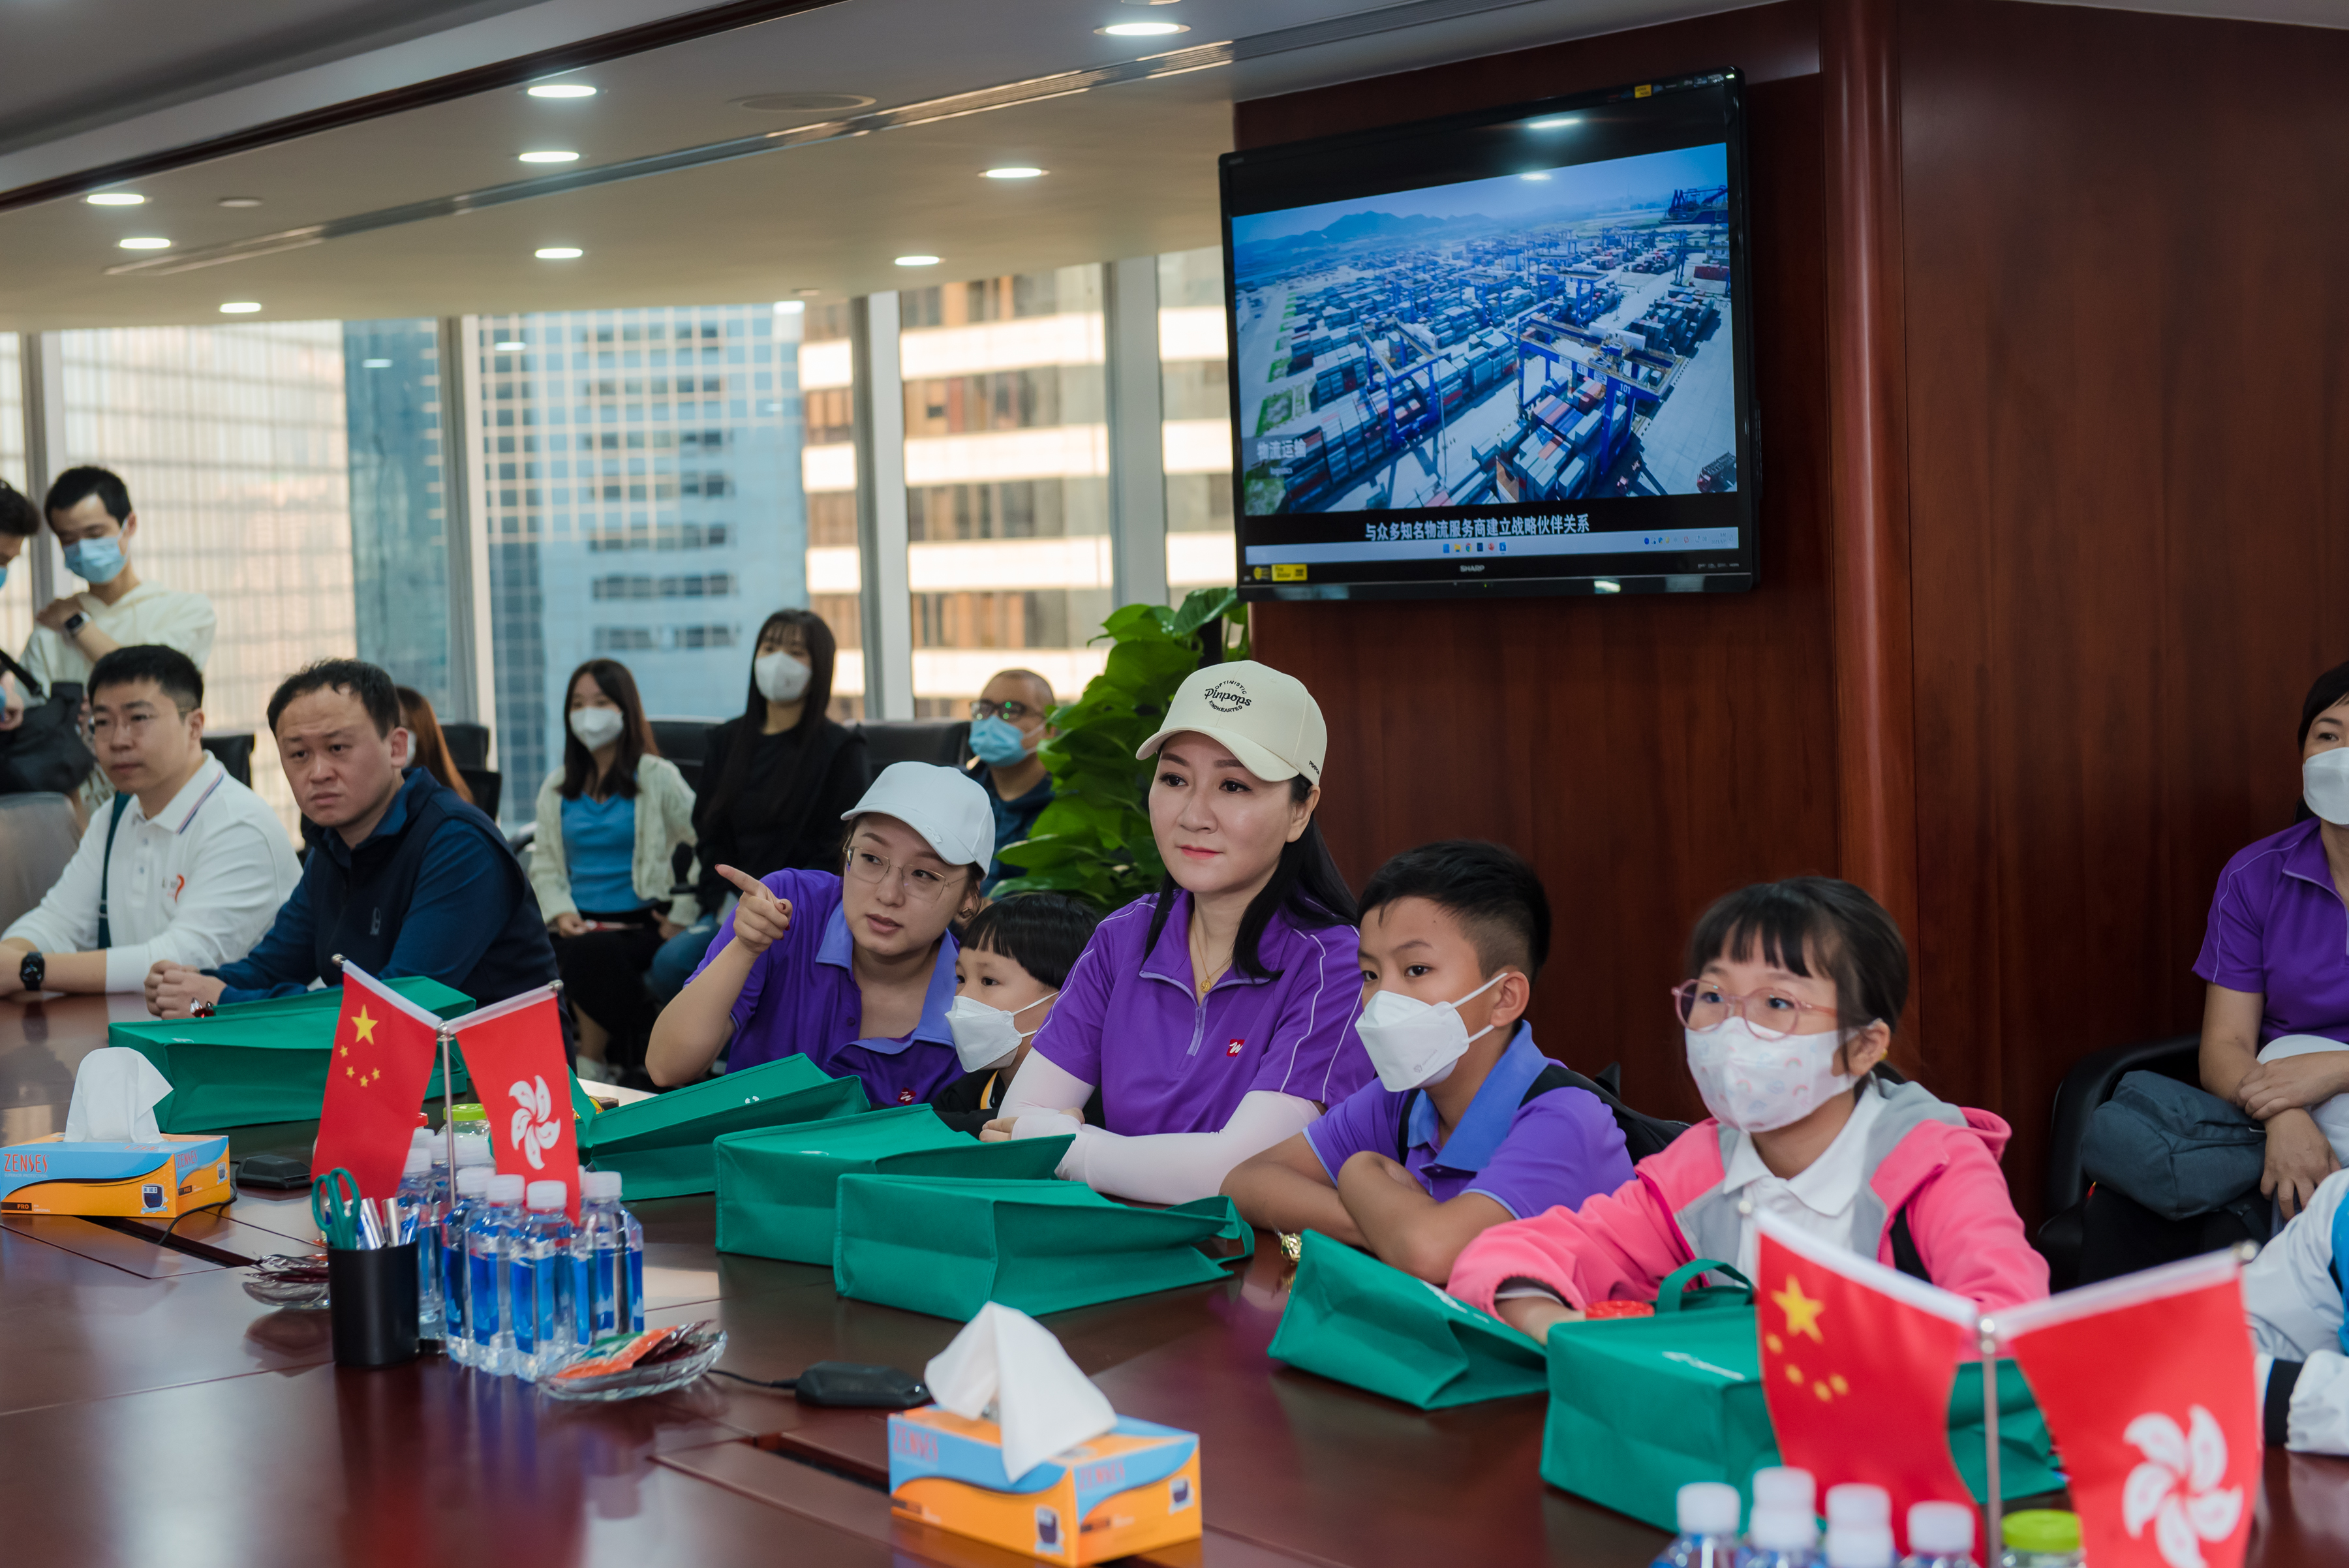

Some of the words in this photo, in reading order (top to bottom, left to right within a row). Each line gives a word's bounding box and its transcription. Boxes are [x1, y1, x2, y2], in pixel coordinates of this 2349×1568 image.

[1257, 438, 1307, 461] 物流运输
[1364, 514, 1589, 541] 与众多知名物流服务商建立战略伙伴关系
[1215, 680, 1247, 694] OPTIMISTIC
[1205, 688, 1251, 706] Pinpops
[1208, 700, 1243, 713] KINDHEARTED
[4, 1153, 48, 1173] ZENSES
